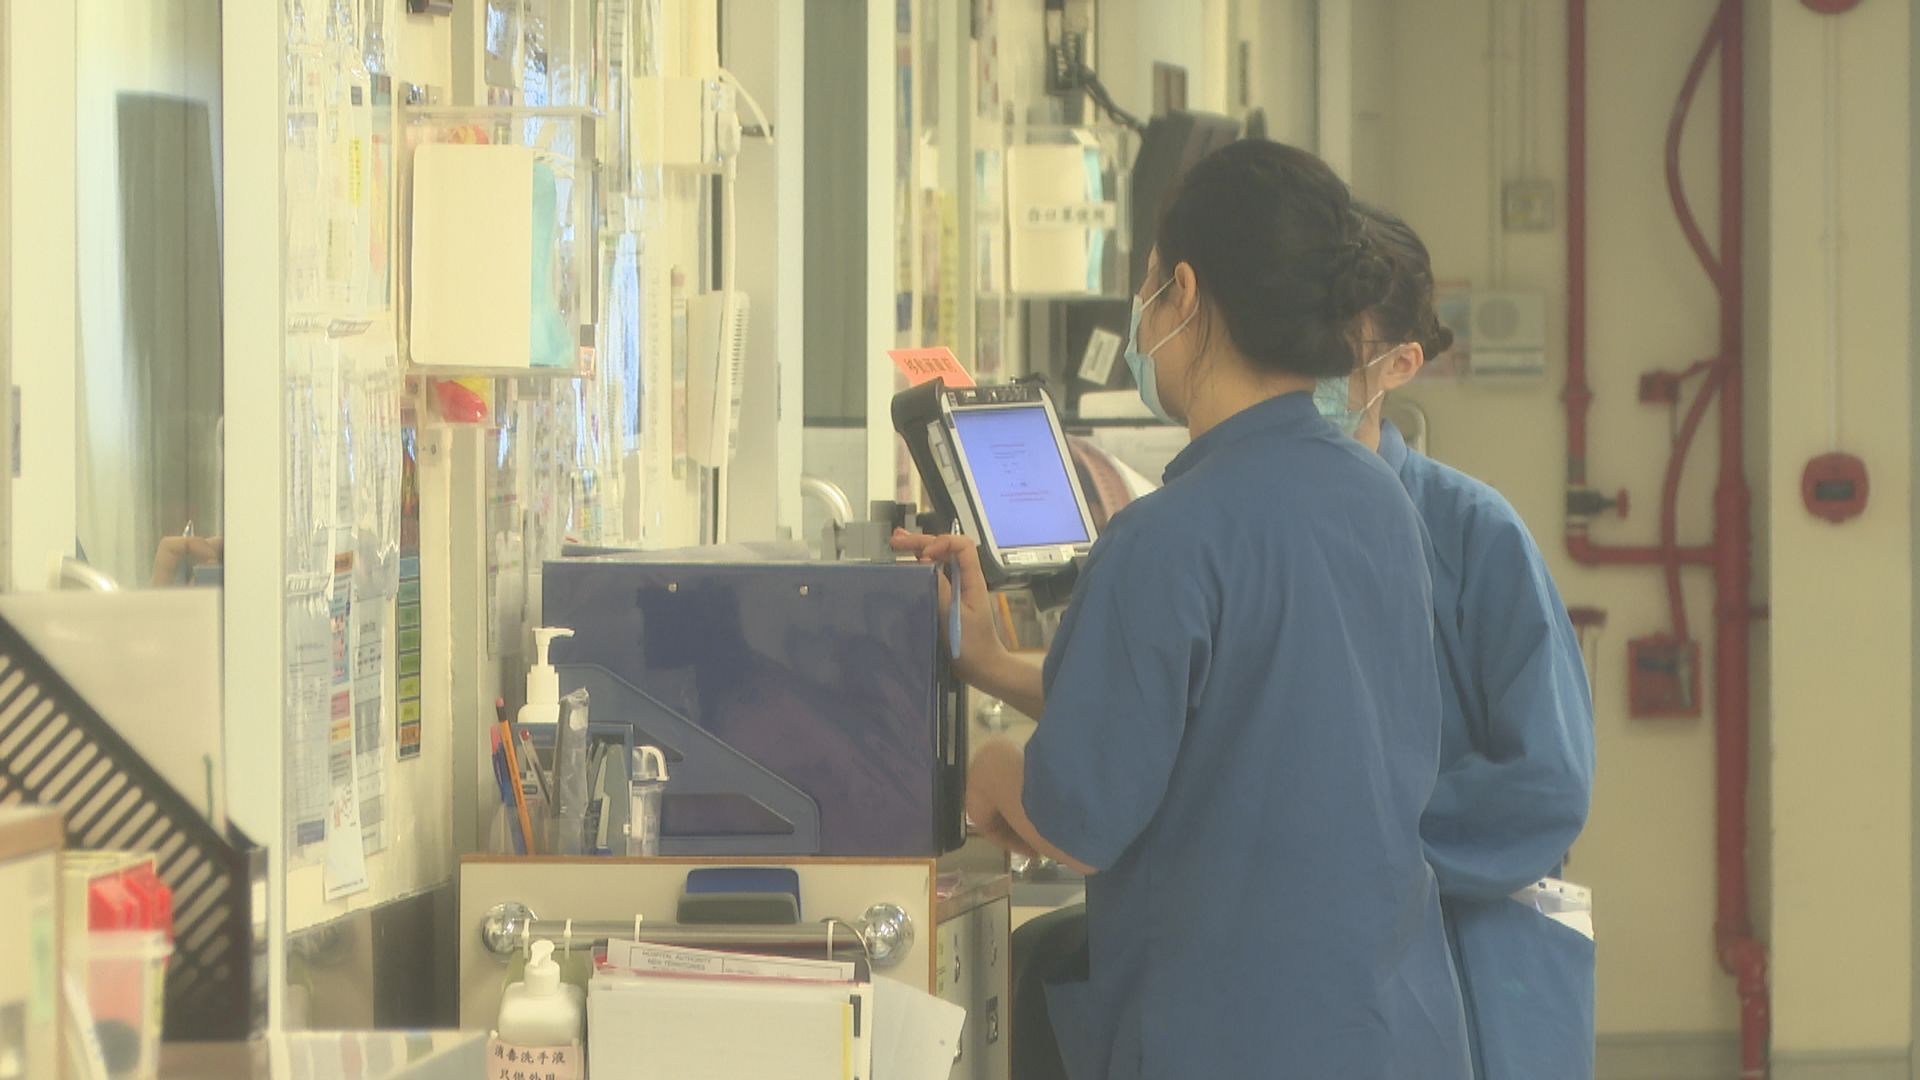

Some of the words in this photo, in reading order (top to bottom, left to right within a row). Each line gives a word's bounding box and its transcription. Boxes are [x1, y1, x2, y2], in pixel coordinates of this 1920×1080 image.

[642, 951, 672, 960] HOSPITAL
[675, 954, 711, 964] AUTHORITY
[664, 960, 706, 971] TERRITORIES
[494, 1044, 566, 1065] 消毒洗手液
